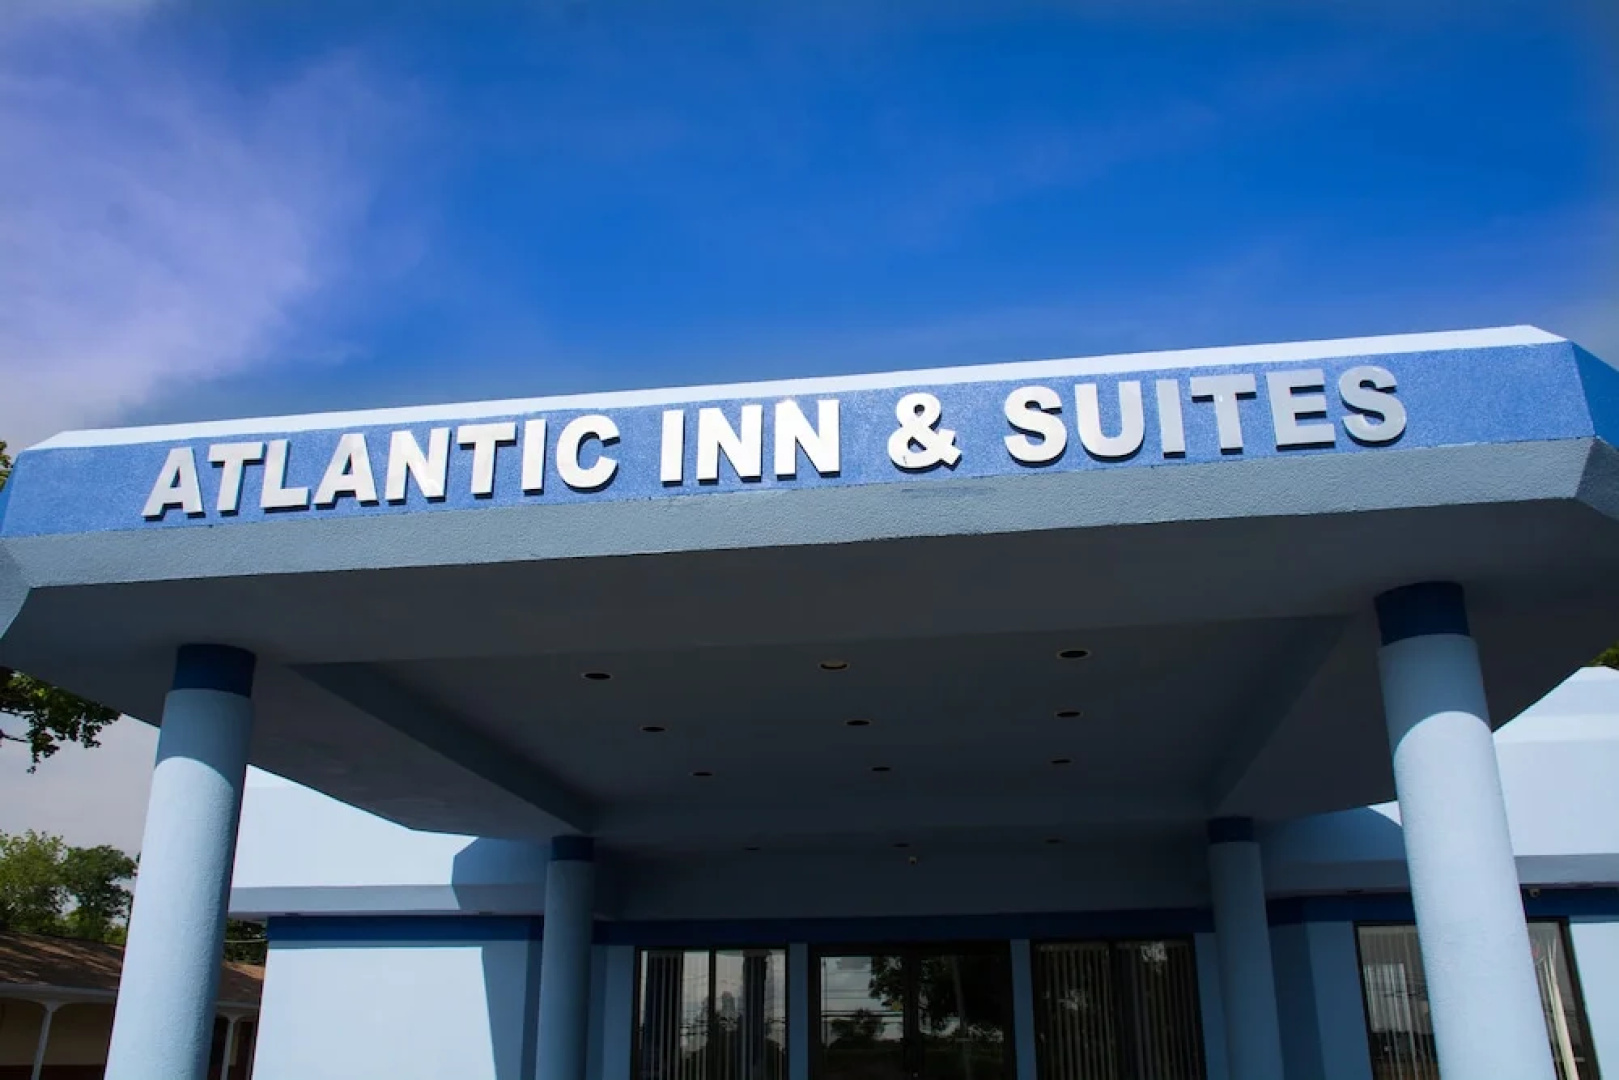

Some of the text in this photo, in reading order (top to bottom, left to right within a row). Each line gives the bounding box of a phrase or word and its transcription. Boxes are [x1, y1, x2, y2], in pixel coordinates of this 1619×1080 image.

[141, 365, 1407, 519] ATLANTIC INN & SUITES
